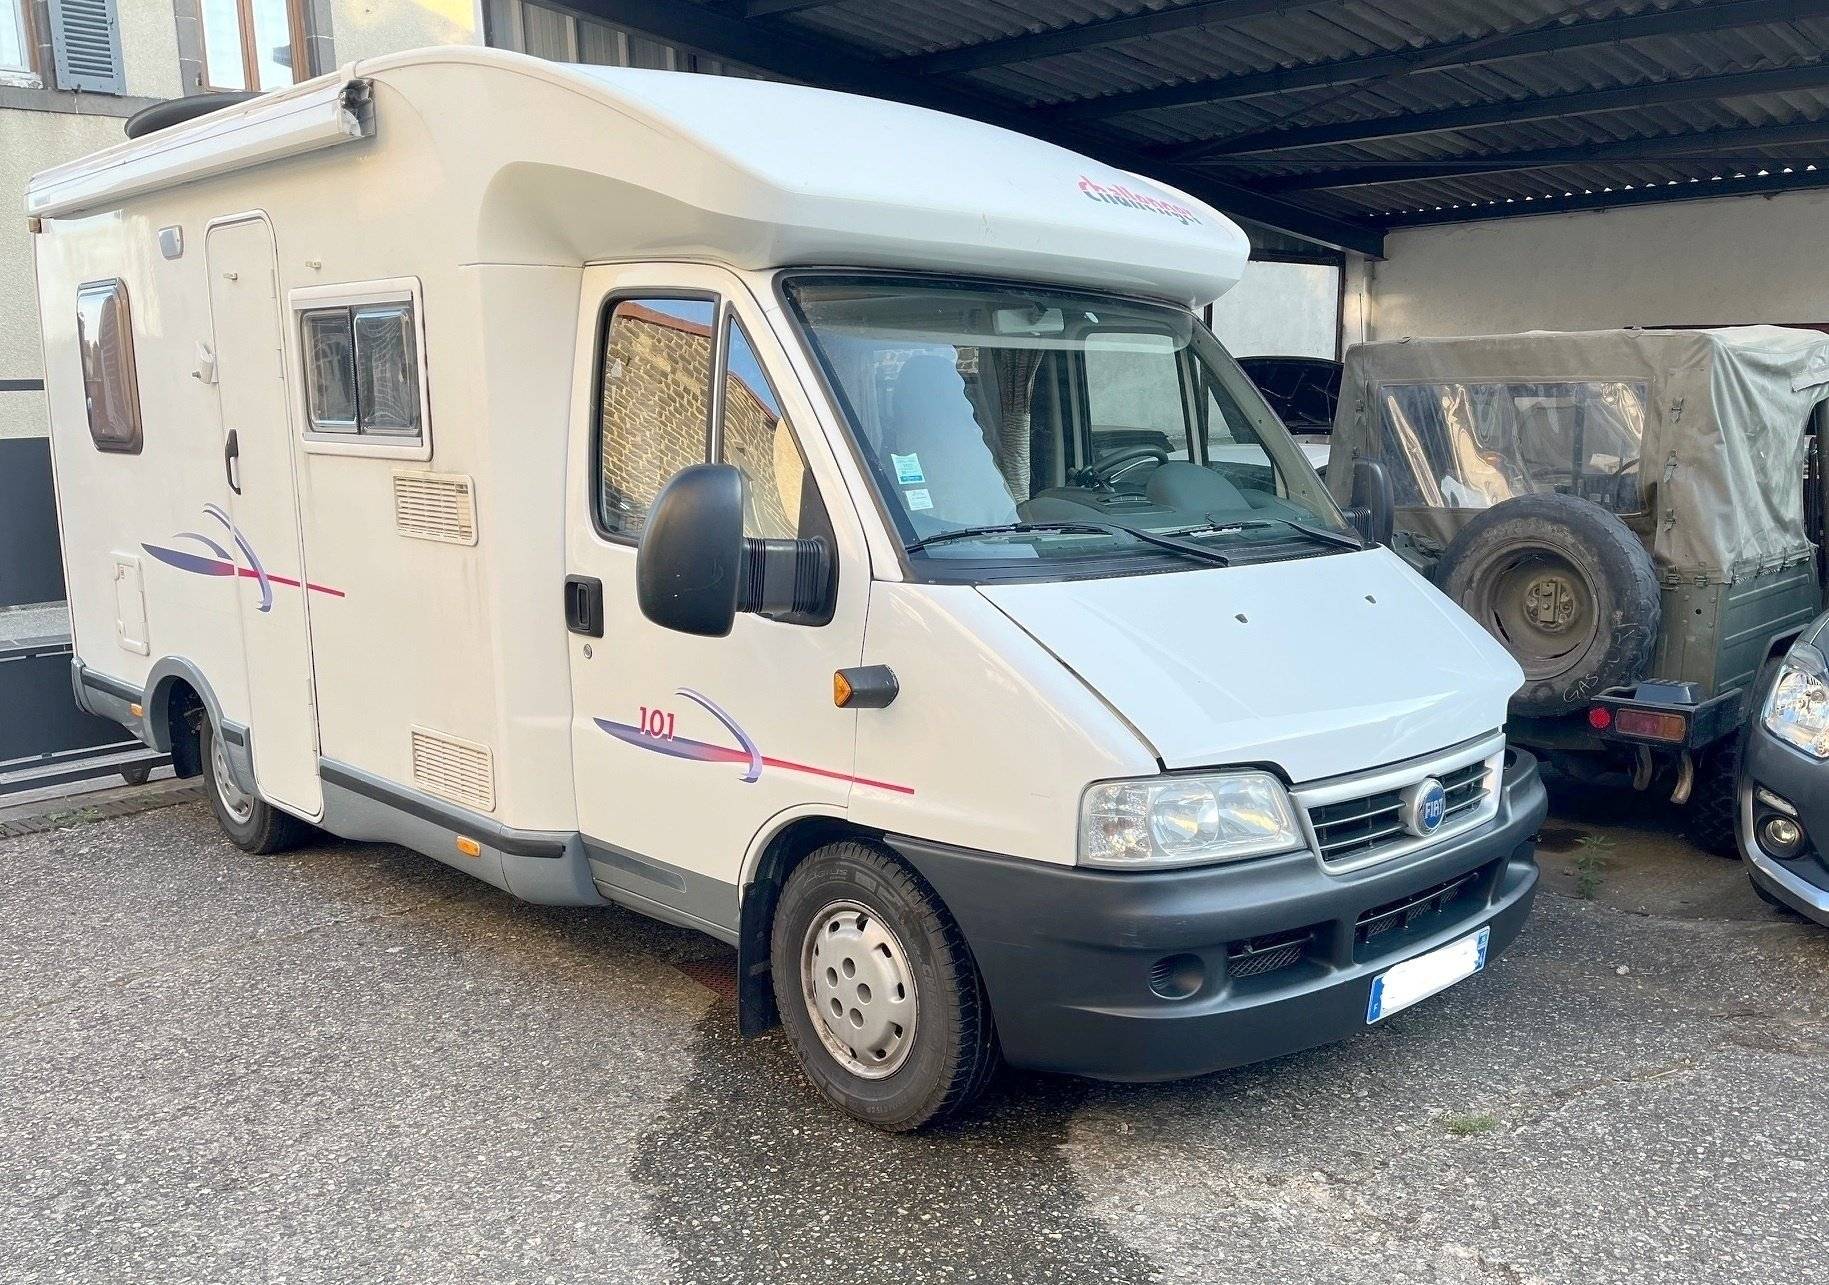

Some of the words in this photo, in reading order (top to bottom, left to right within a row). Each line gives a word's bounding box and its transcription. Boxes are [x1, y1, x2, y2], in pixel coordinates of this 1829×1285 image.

[1563, 673, 1599, 703] GAS
[640, 706, 675, 740] 101
[1425, 798, 1444, 819] FIAT
